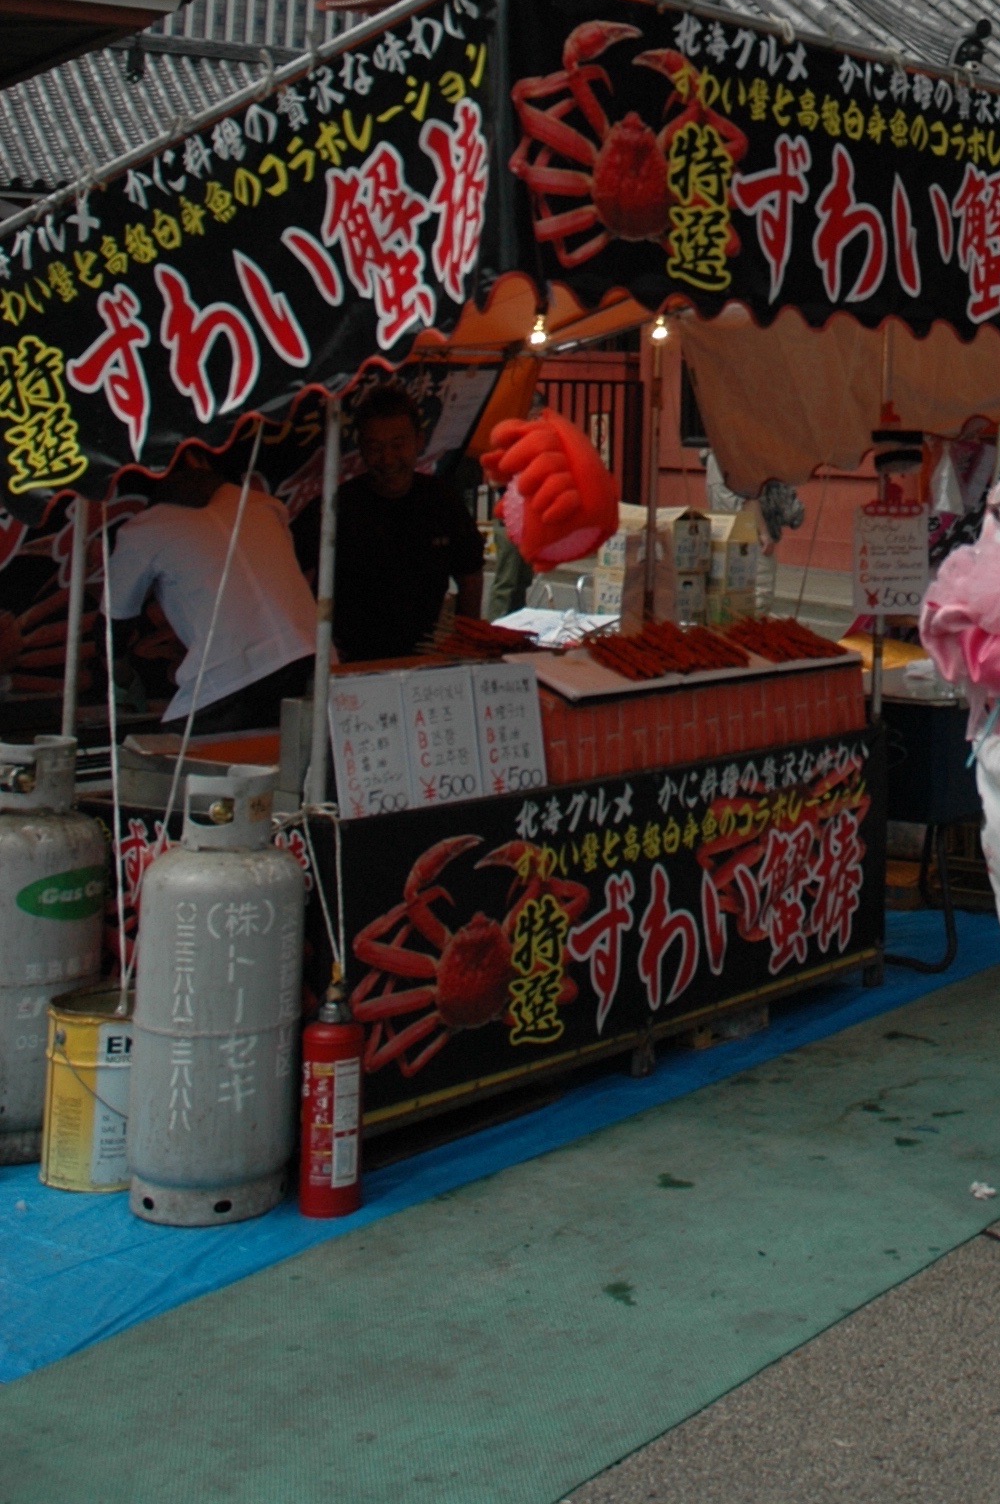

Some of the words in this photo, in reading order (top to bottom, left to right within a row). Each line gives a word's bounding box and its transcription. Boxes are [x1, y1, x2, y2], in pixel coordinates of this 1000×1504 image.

[665, 120, 734, 292] 特選
[66, 97, 490, 461] ずわい蟹棒
[0, 335, 89, 494] 特選
[414, 707, 426, 728] A
[484, 705, 493, 721] A
[417, 730, 429, 750] B
[486, 727, 496, 745] B
[420, 751, 432, 768] C
[489, 747, 499, 765] C
[418, 773, 477, 802] ¥500
[489, 765, 544, 795] ¥500
[566, 809, 863, 1036] ずわい蟹棒
[509, 893, 569, 1046] 特選
